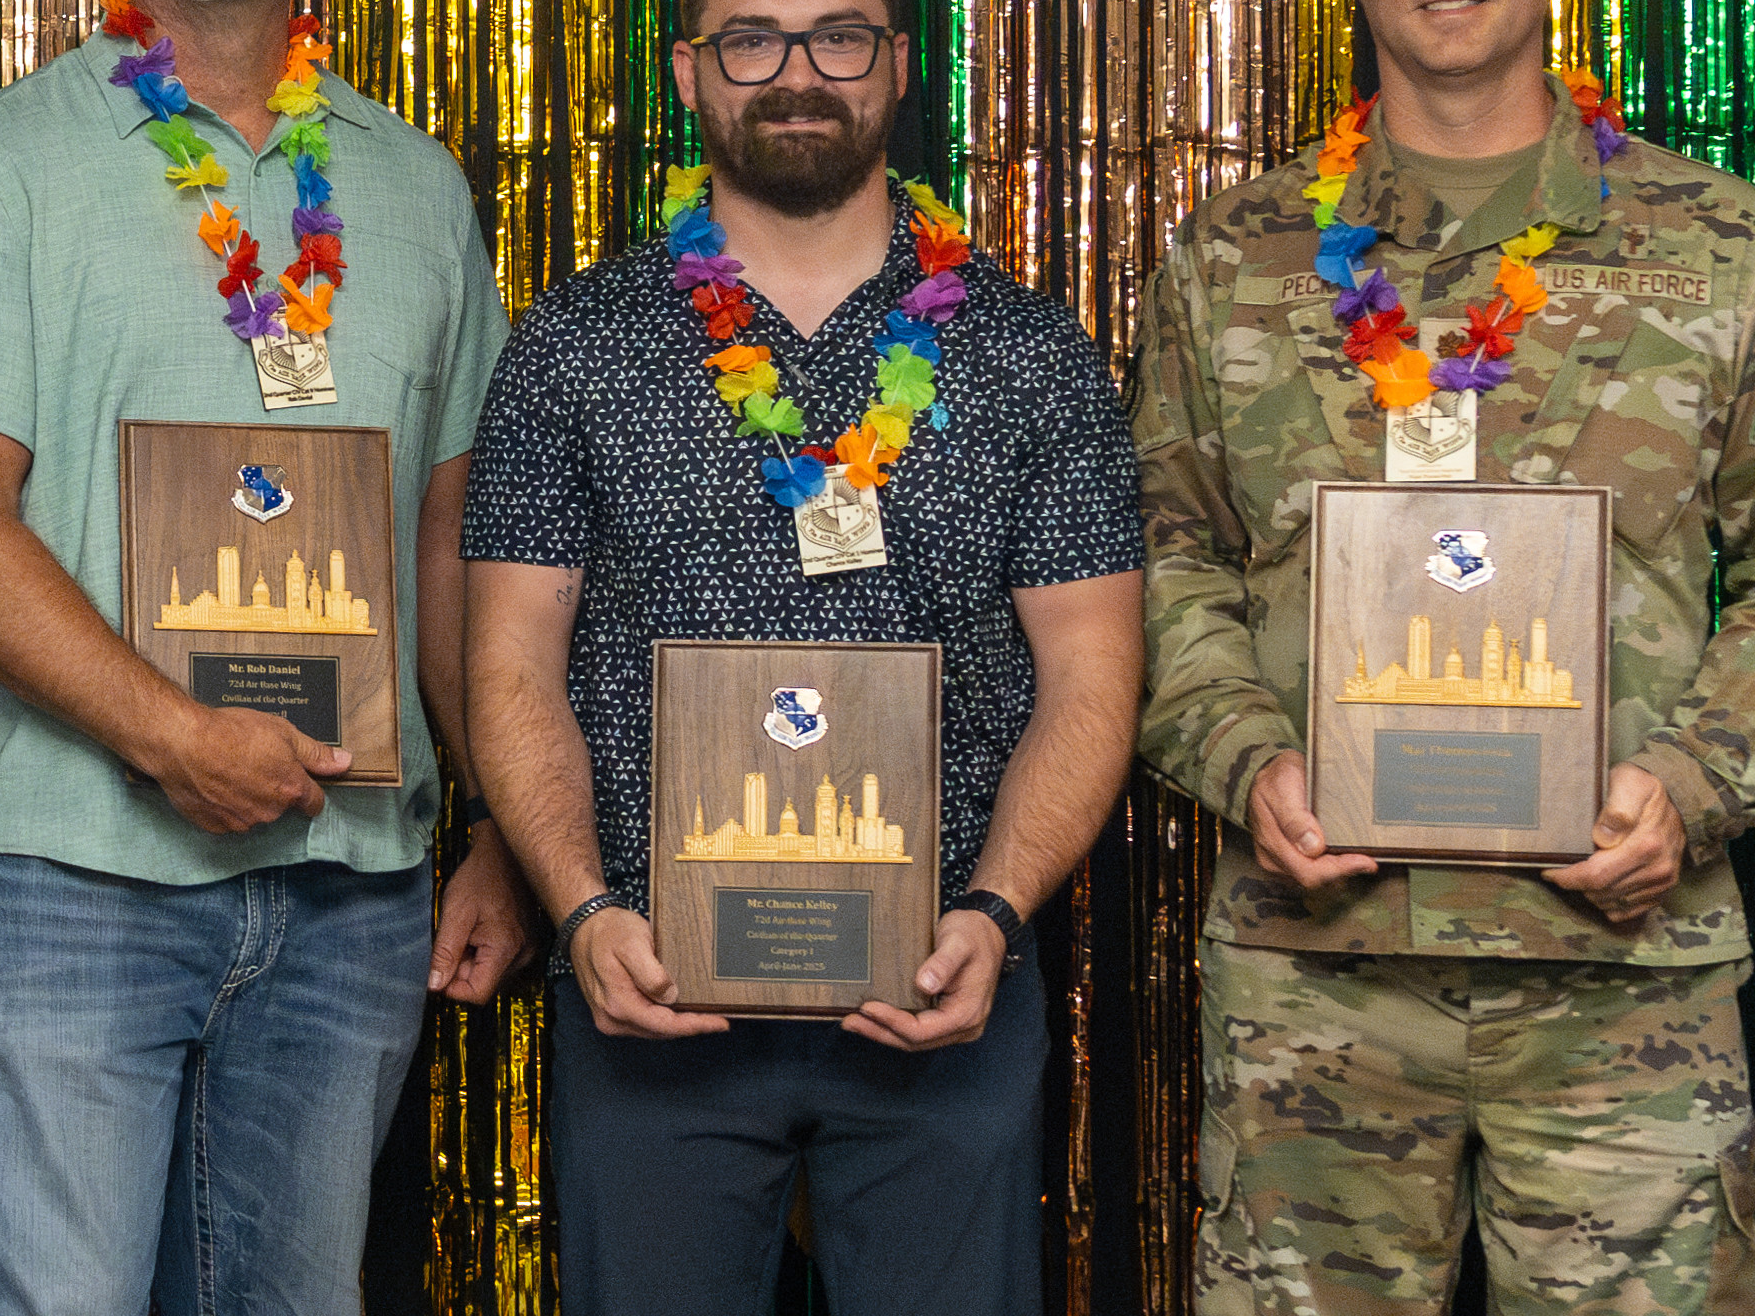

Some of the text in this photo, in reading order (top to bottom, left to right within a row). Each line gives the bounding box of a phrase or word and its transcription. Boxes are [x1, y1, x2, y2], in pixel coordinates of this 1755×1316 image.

[1595, 270, 1631, 292] AIR
[1638, 273, 1708, 301] FORCE
[246, 664, 266, 673] Rob
[268, 665, 301, 675] Daniel
[221, 694, 309, 705] Civilian of the Quarter
[765, 898, 804, 910] Chance
[805, 899, 838, 912] Kelley
